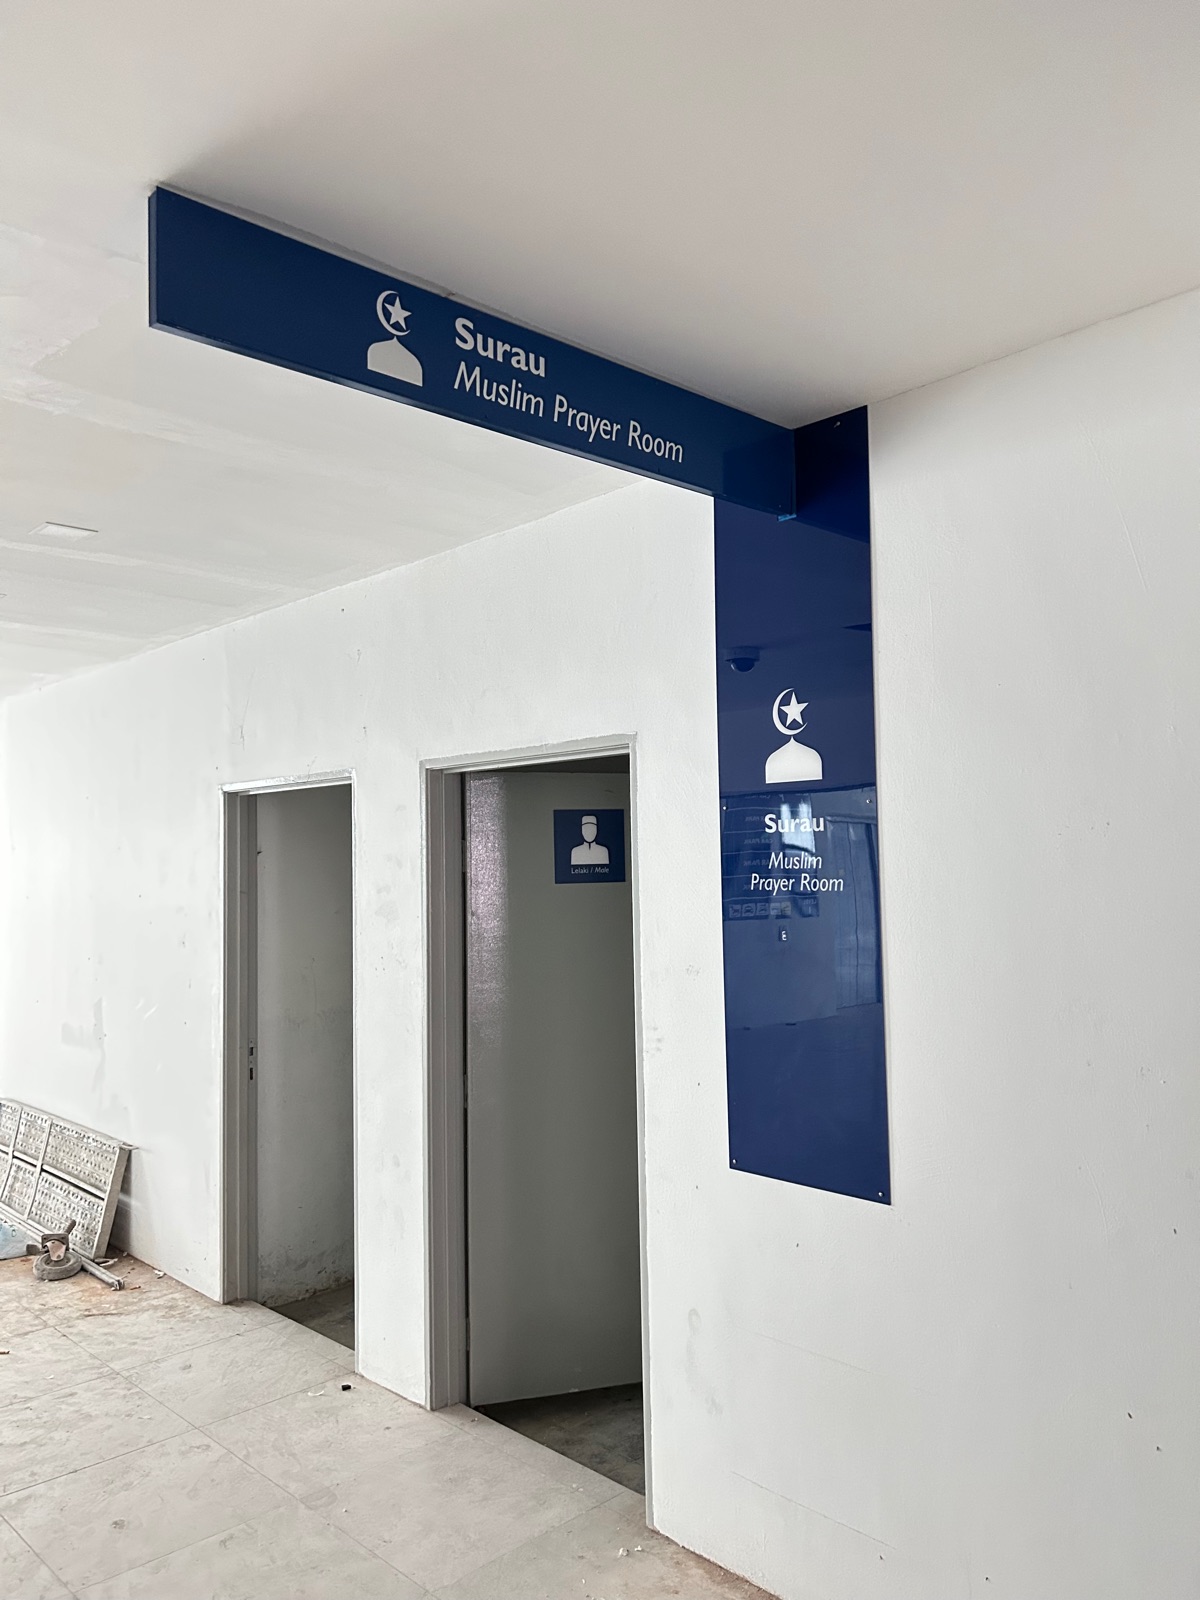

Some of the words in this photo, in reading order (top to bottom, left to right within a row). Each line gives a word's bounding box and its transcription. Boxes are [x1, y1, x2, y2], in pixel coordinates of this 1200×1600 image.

[454, 316, 547, 378] Surau
[453, 360, 545, 418] Muslim
[553, 393, 621, 443] Prayer
[627, 419, 684, 463] Room
[764, 813, 825, 834] Surau
[594, 866, 610, 874] Male
[768, 851, 823, 870] Muslim
[750, 872, 796, 896] Prayer
[800, 872, 844, 892] Room
